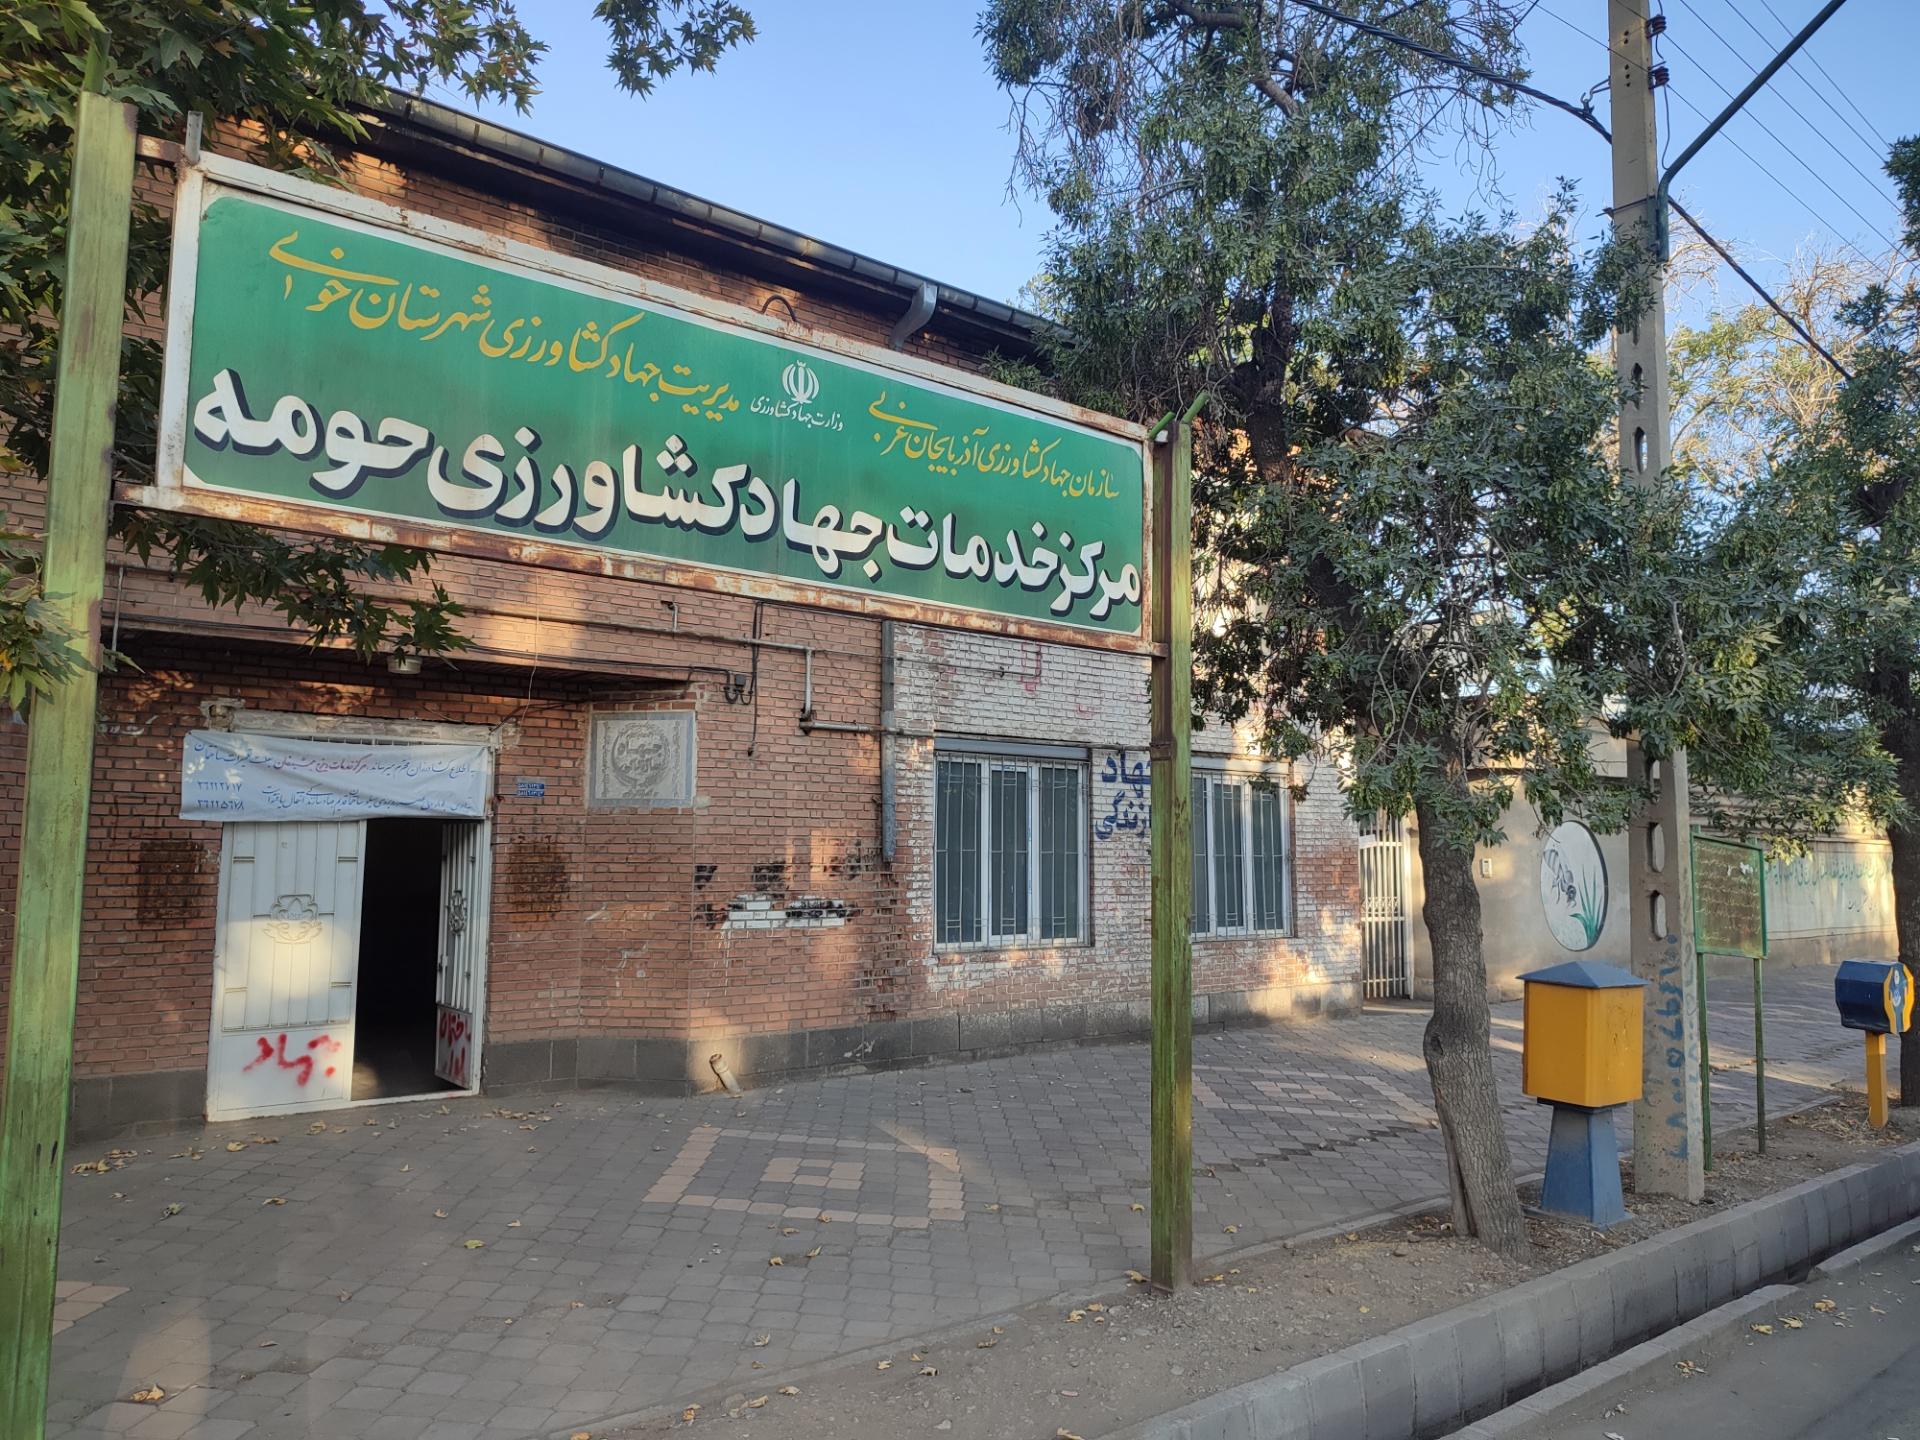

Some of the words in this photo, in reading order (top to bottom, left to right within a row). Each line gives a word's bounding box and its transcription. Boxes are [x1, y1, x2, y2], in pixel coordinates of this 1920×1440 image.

[347, 283, 492, 343] شهرستان
[478, 311, 646, 375] کشاورزی
[605, 342, 661, 404] جهاد
[657, 362, 742, 422] مدیریت
[193, 367, 434, 499] حومه
[750, 394, 800, 418] کشاورزی
[792, 403, 813, 430] جهاد
[811, 410, 845, 432] وزارت
[868, 390, 939, 456] غربی
[904, 425, 991, 477] آذربایجان
[976, 437, 1062, 480] کشاورزی
[1040, 459, 1071, 498] جهاد
[426, 428, 750, 541] کشاورزی
[1068, 468, 1121, 499] سازمان
[740, 477, 885, 583] جهاد
[886, 505, 1061, 590] خدمات
[1050, 531, 1142, 620] مرکز
[353, 753, 373, 774] مرکز
[449, 763, 470, 779] اطلاع
[1101, 750, 1152, 799] هاد
